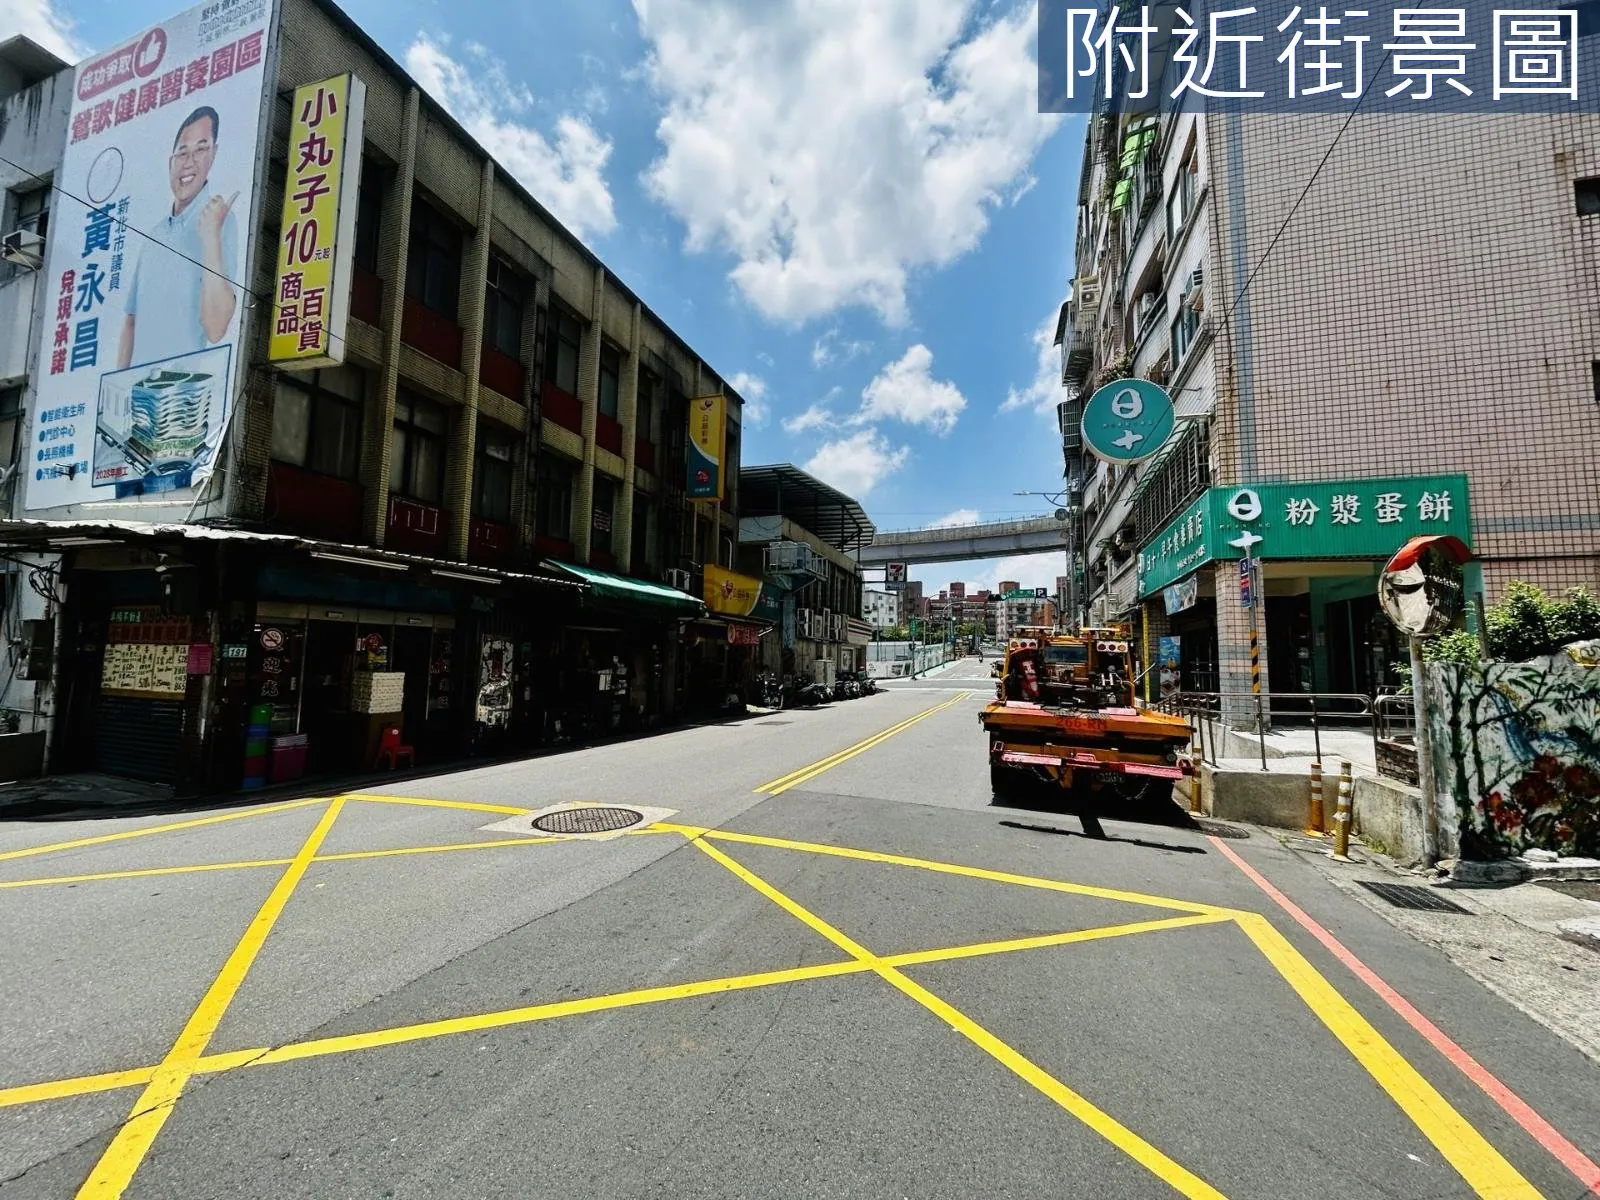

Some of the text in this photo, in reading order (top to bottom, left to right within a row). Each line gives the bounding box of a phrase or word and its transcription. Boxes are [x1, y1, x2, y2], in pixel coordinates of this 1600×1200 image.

[70, 28, 265, 145] 鶯歌健康醫養園區
[80, 53, 132, 92] 成功爭取
[293, 87, 337, 215] 小丸子
[108, 195, 131, 292] 新北市議員
[285, 218, 317, 266] 10
[70, 202, 117, 372] 黃永昌
[276, 272, 304, 335] 商品
[297, 287, 325, 352] 百貨
[1285, 490, 1454, 526] 粉漿蛋餅
[230, 648, 246, 657] 191
